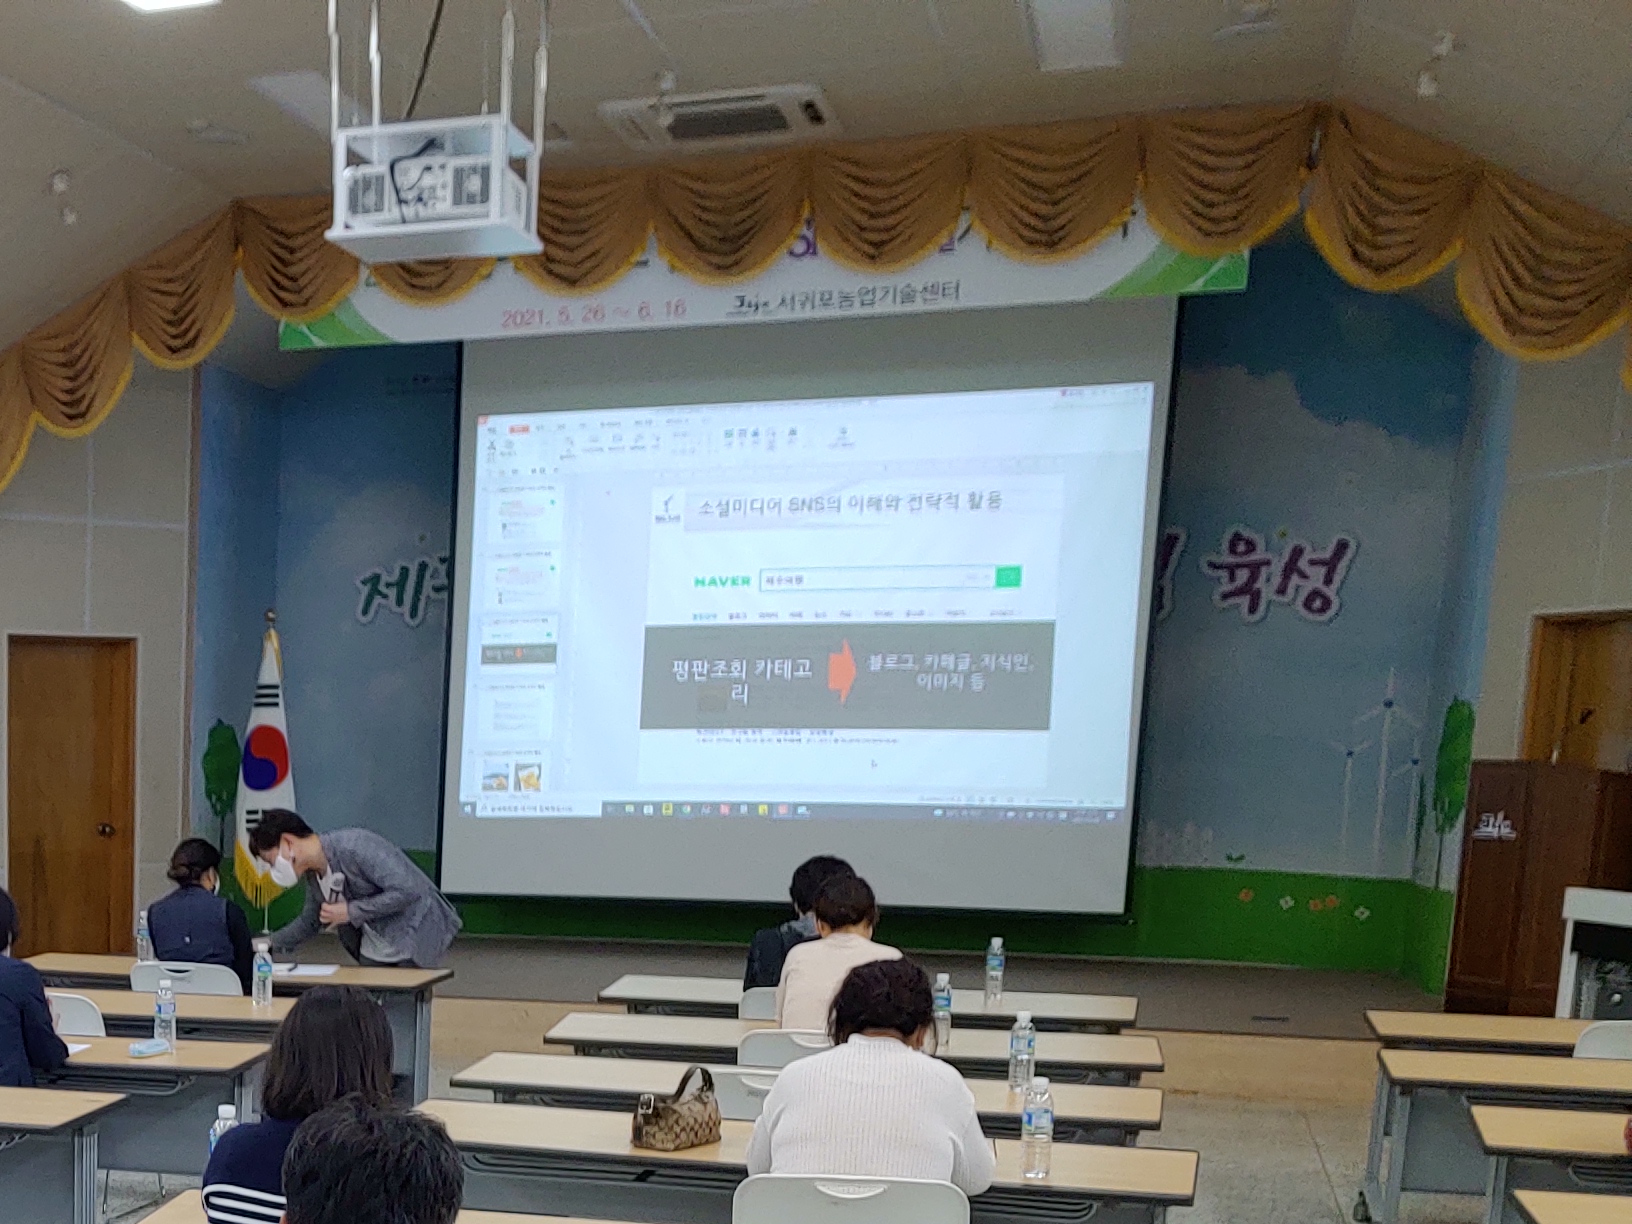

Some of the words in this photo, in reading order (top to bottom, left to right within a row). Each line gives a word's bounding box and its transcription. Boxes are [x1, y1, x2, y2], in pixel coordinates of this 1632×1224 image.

[776, 279, 961, 312] 서귀포농업기술센터
[502, 307, 550, 329] 2021.
[699, 497, 782, 518] 소셜미디어
[788, 495, 841, 513] SNS의
[848, 494, 901, 514] 이해와
[907, 492, 959, 511] 전략적
[968, 490, 1002, 511] 활용
[694, 576, 750, 587] NAVER
[1204, 530, 1353, 618] 육성
[672, 658, 747, 682] 평판조회
[753, 658, 812, 681] 카테고
[918, 673, 964, 691] 이미지
[971, 672, 985, 692] 등
[731, 683, 748, 705] 리
